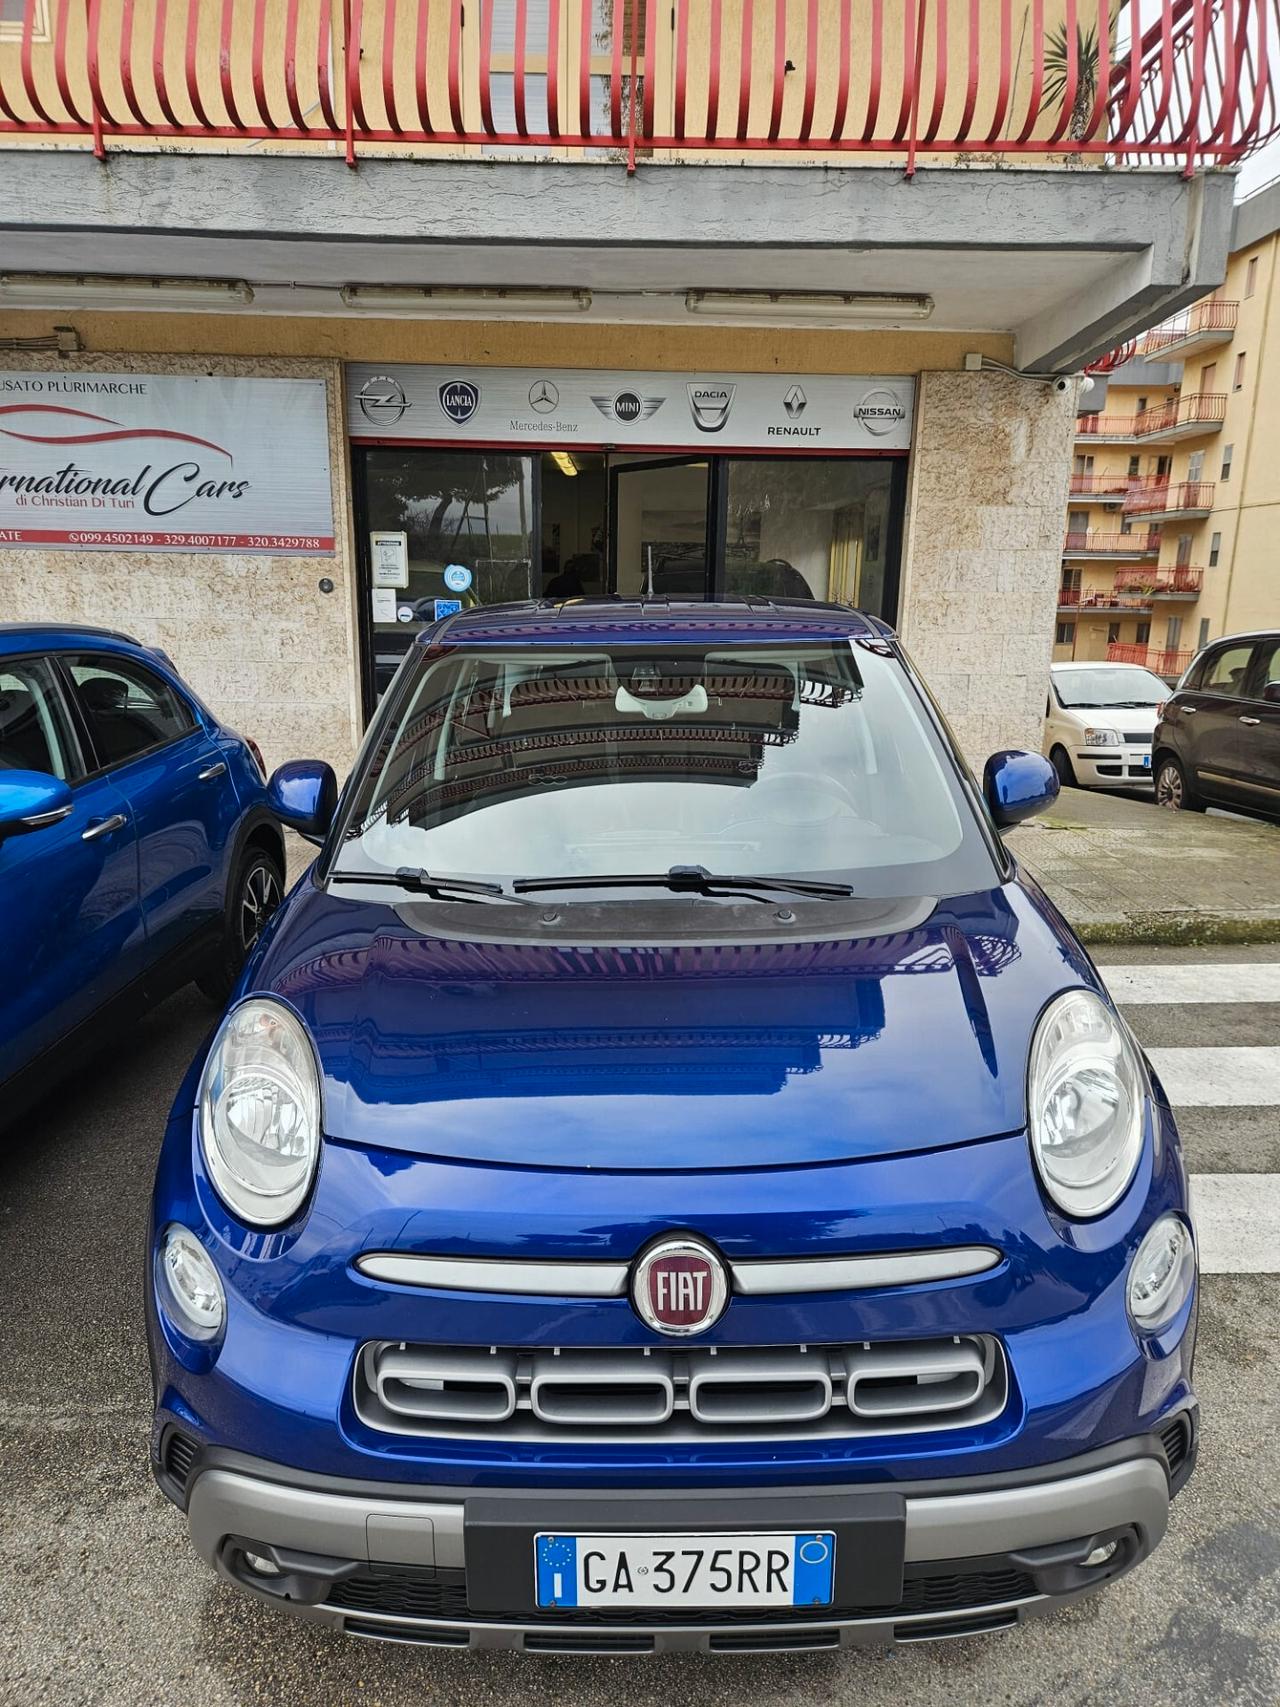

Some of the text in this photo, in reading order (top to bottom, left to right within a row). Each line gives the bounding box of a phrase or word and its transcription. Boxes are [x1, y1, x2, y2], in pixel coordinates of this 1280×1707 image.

[47, 380, 148, 395] PLURIMARCHE
[694, 390, 728, 399] DACIA
[446, 394, 472, 407] LANCIA
[616, 400, 639, 413] MINI
[858, 407, 901, 417] NISSAN
[509, 420, 578, 433] Mercedes-Benz
[767, 426, 821, 437] RENAULT
[144, 462, 251, 516] Cars
[16, 494, 135, 509] di Christian Di Turi
[80, 533, 154, 544] 099.4502149
[164, 535, 237, 546] 329.4007177
[247, 536, 320, 548] 320.3429788
[656, 1271, 708, 1311] FIAT
[583, 1549, 790, 1593] GA 375RR
